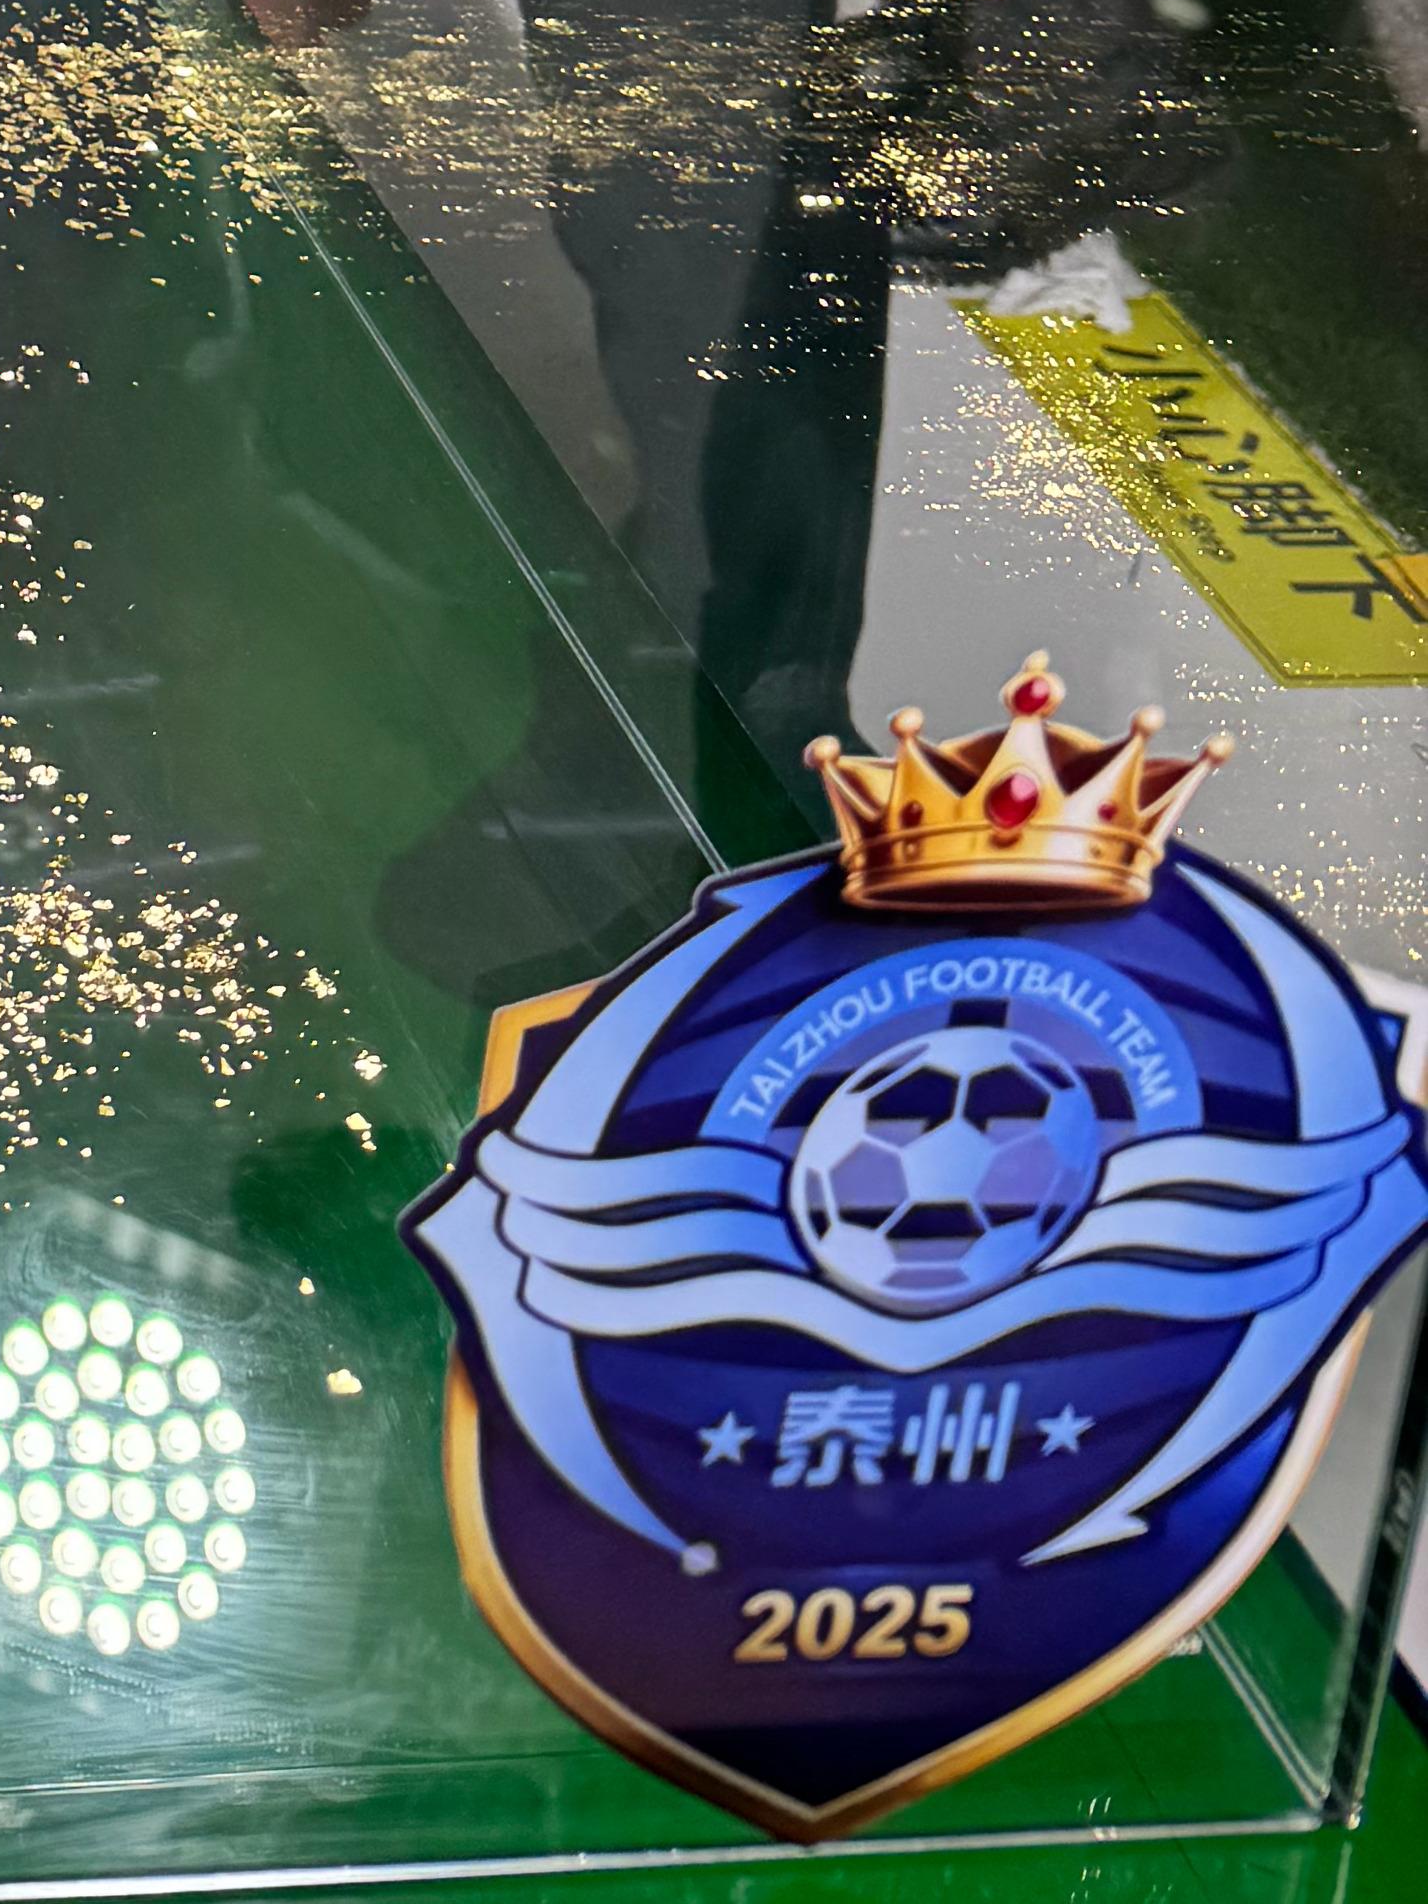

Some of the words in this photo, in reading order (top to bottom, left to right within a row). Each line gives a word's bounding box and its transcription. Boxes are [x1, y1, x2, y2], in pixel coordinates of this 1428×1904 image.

[1093, 342, 1428, 625] 小心脚下
[904, 956, 1111, 1029] FOOTBALL
[1105, 1007, 1177, 1110] TEAM
[770, 1382, 1021, 1487] 泰州
[733, 1583, 974, 1662] 2025
